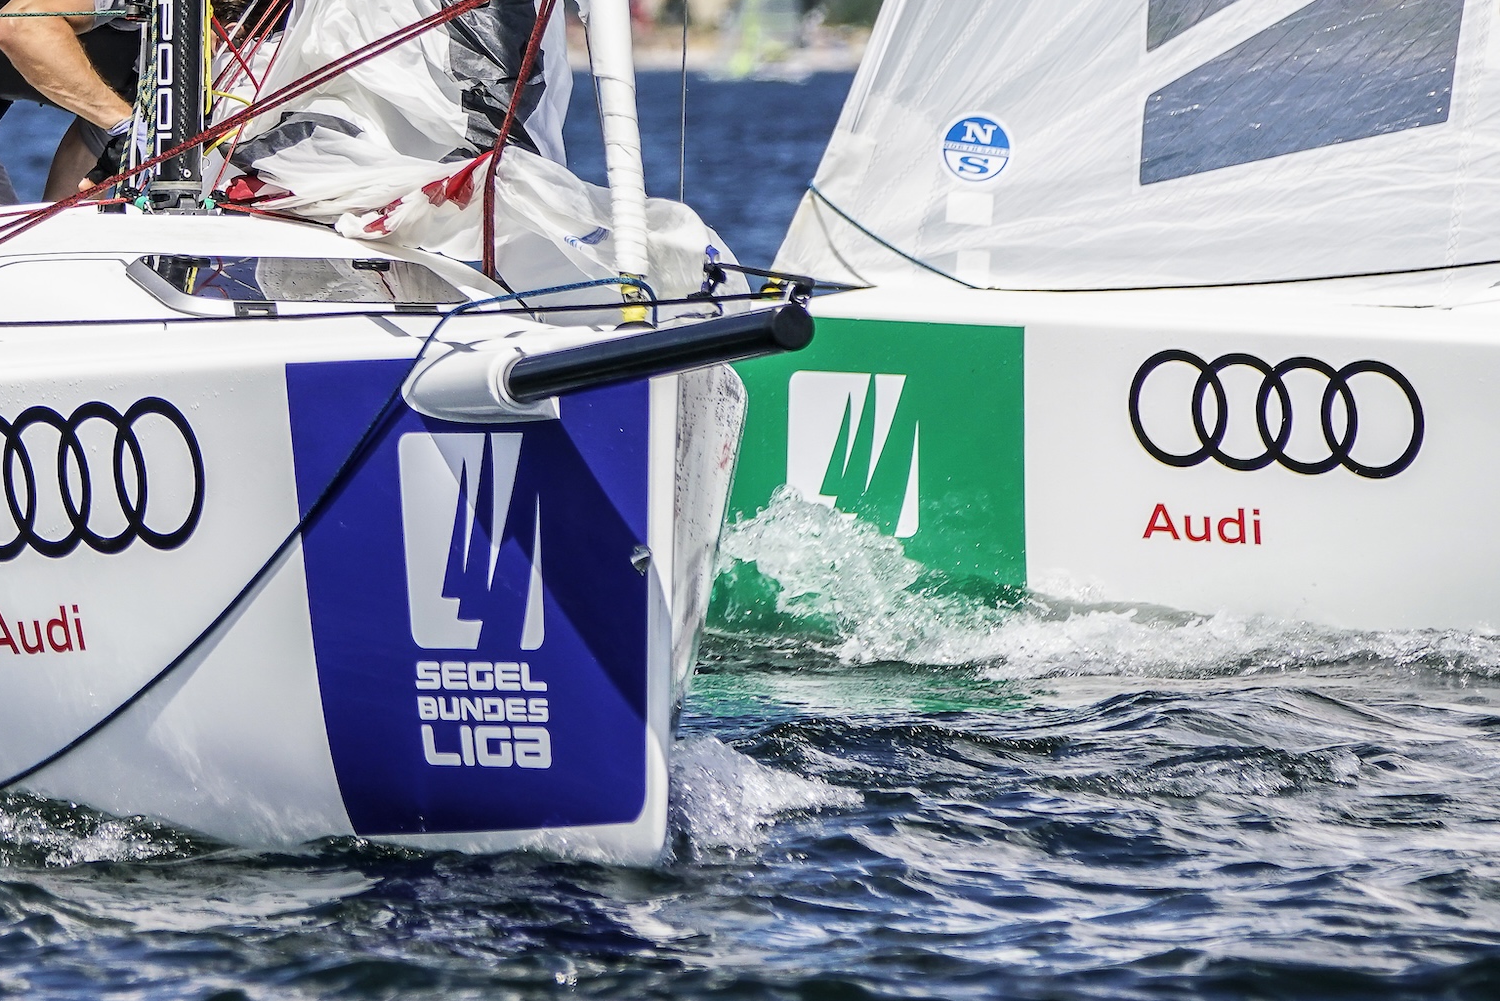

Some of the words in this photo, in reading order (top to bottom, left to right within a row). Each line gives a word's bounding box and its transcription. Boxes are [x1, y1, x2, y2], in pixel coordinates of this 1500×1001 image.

[961, 120, 998, 145] N
[958, 156, 989, 174] S
[1142, 503, 1262, 545] Audi
[415, 660, 548, 692] SEGEL
[416, 695, 549, 723] BUNDES
